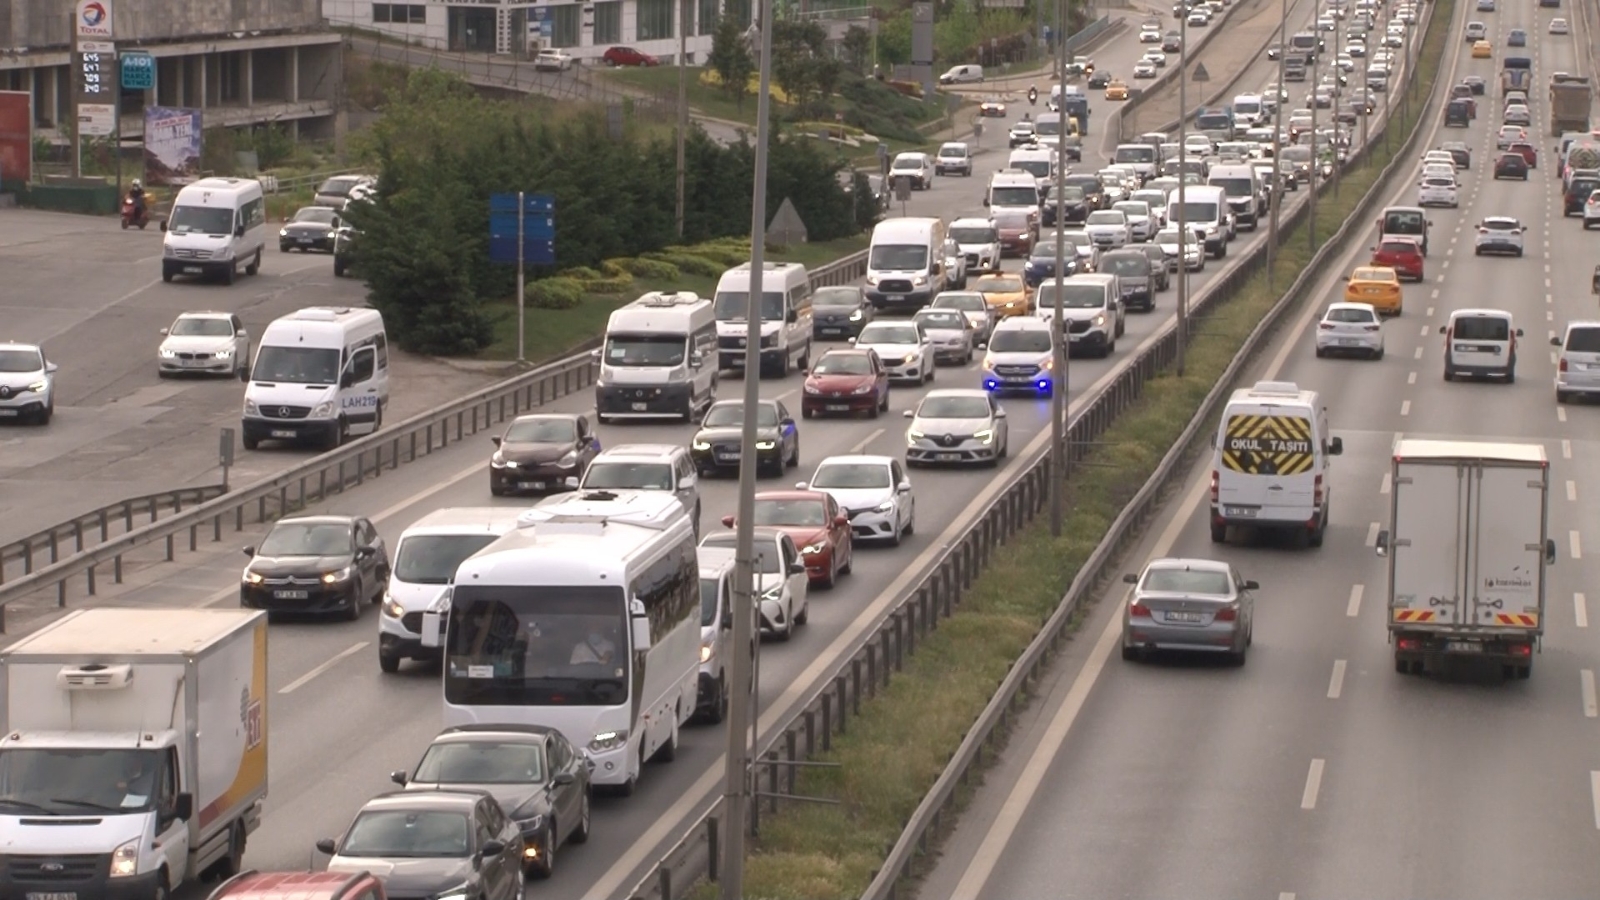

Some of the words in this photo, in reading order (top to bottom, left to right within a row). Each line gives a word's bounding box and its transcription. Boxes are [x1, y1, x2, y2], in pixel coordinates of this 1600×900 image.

[80, 26, 109, 34] TOTAL
[342, 396, 376, 408] LAH219
[1231, 438, 1262, 450] OKUL
[1270, 440, 1308, 452] TAŞITI
